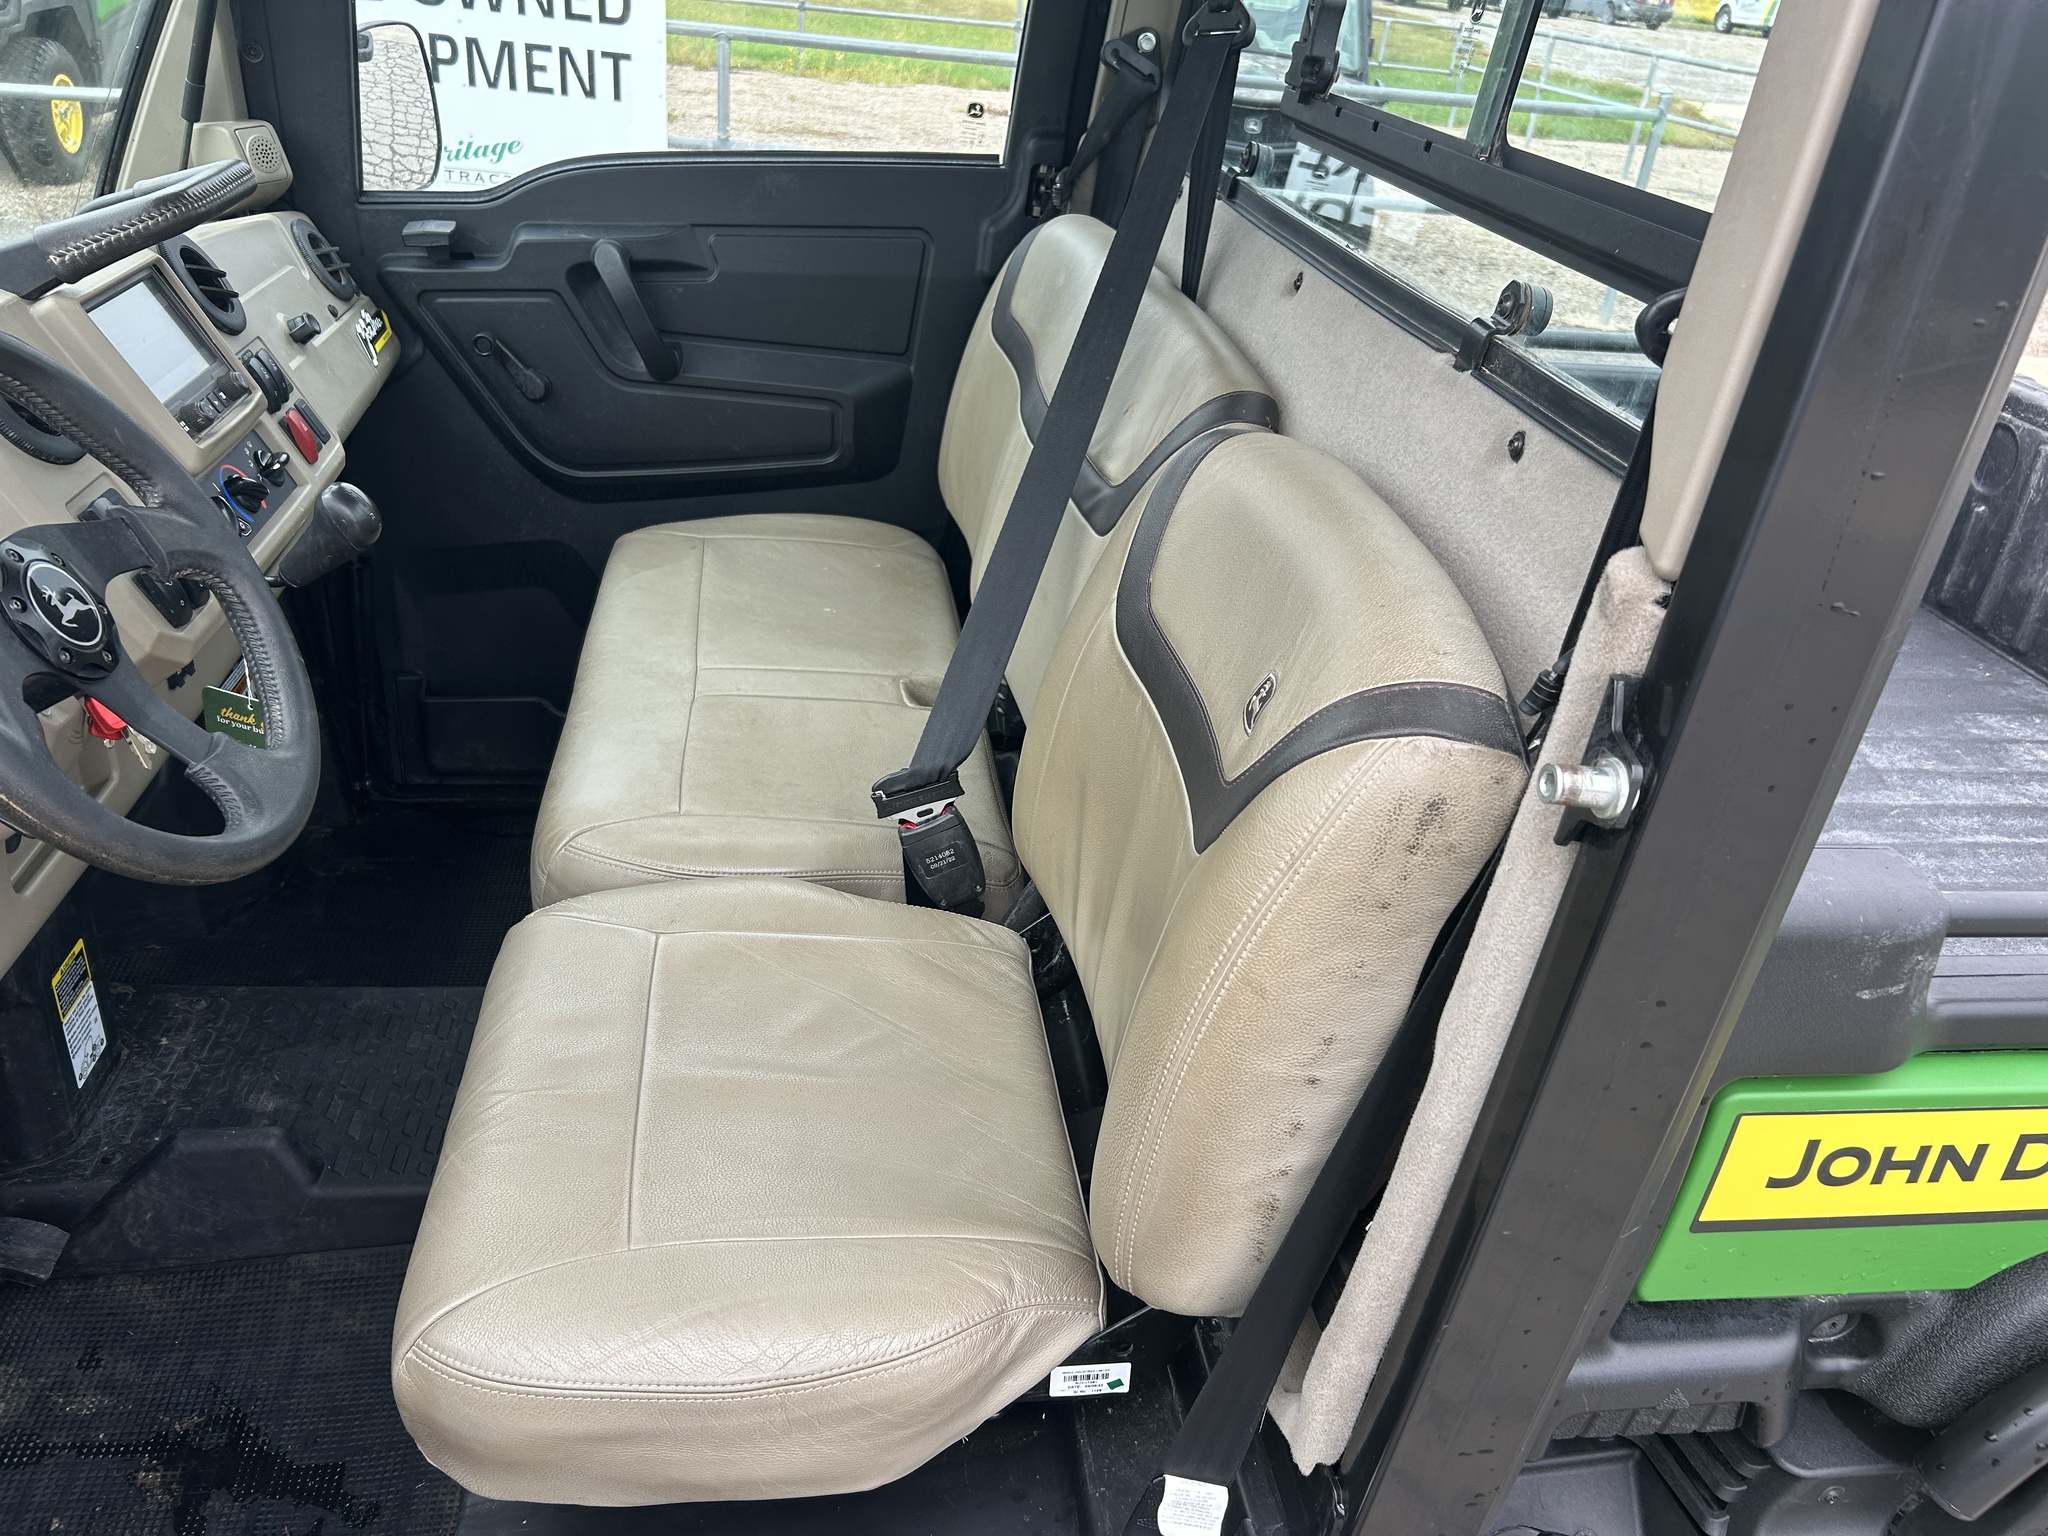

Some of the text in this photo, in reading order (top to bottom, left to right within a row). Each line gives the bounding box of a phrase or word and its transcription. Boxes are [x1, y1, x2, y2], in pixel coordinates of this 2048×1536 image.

[221, 707, 257, 725] thank
[231, 720, 252, 731] your
[1765, 1139, 1989, 1188] JOHN
